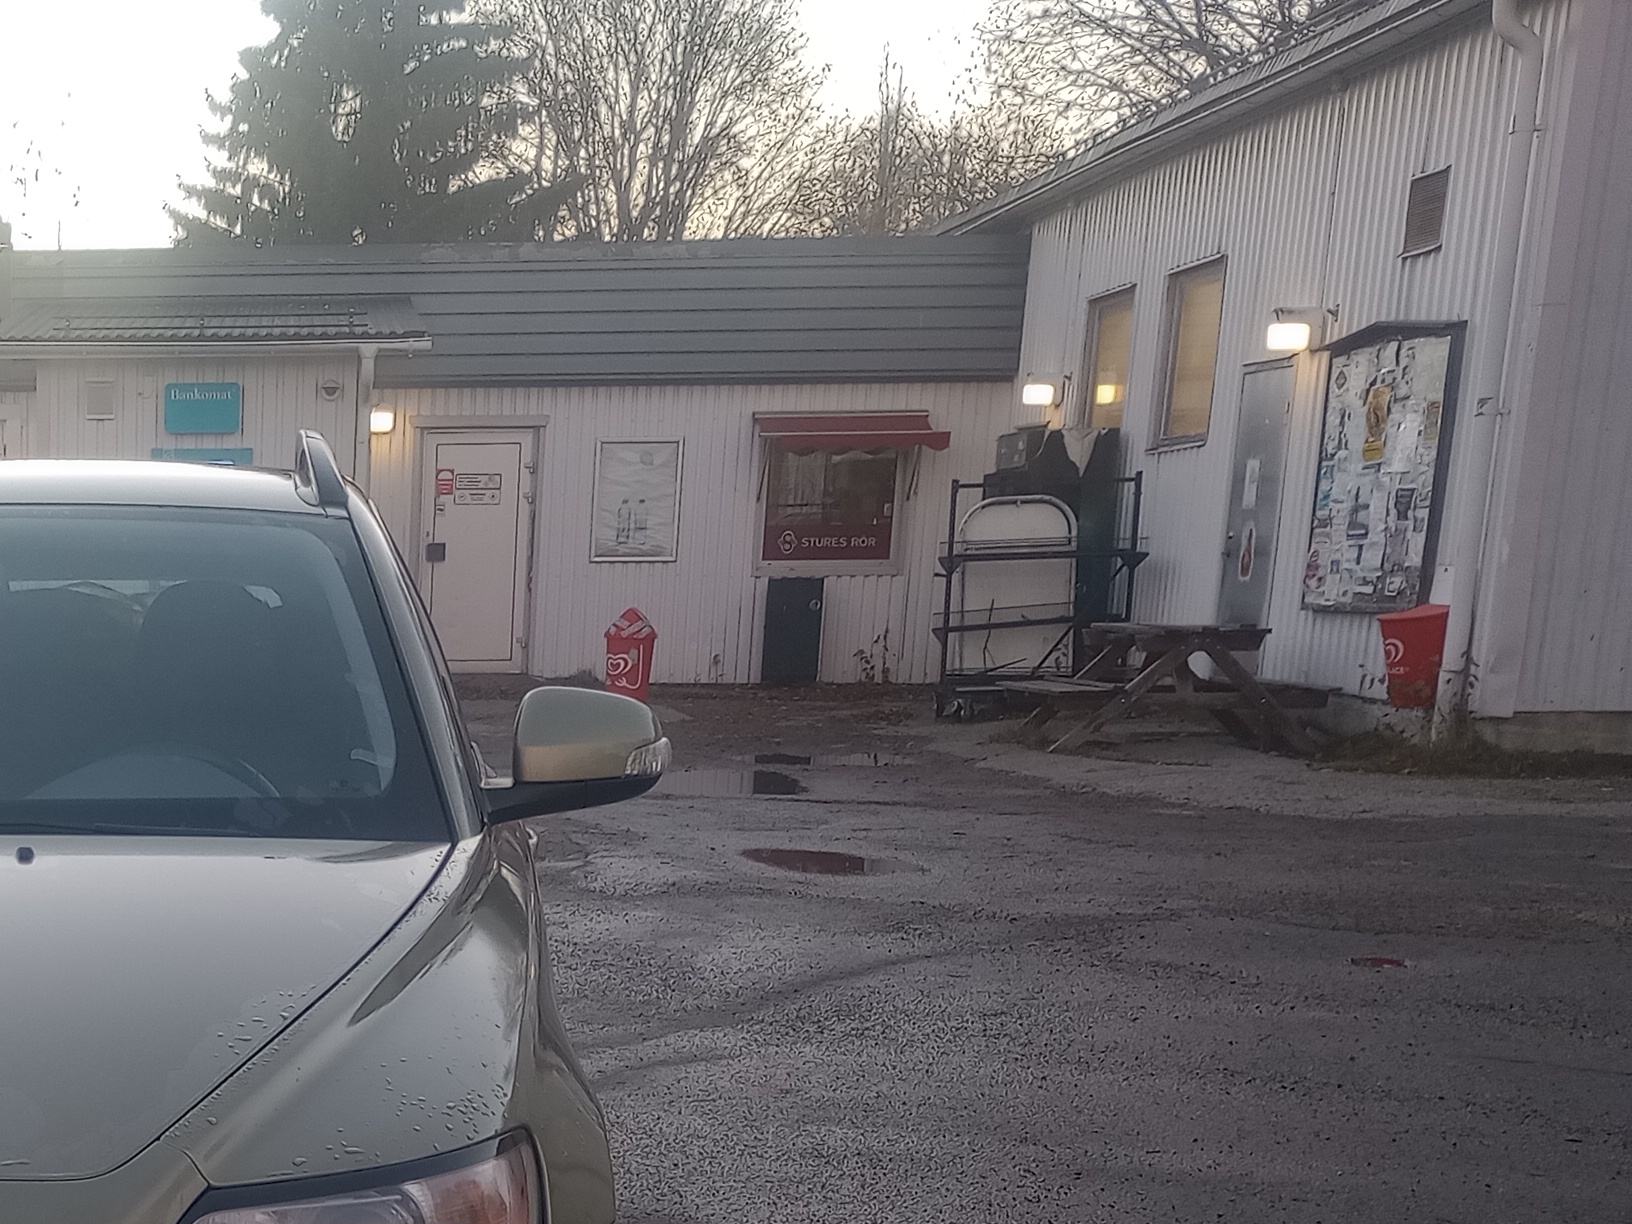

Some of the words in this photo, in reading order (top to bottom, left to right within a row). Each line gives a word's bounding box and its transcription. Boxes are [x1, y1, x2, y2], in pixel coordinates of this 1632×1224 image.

[170, 387, 232, 400] Bankomat
[801, 537, 847, 548] STURES
[851, 535, 876, 547] RÖR
